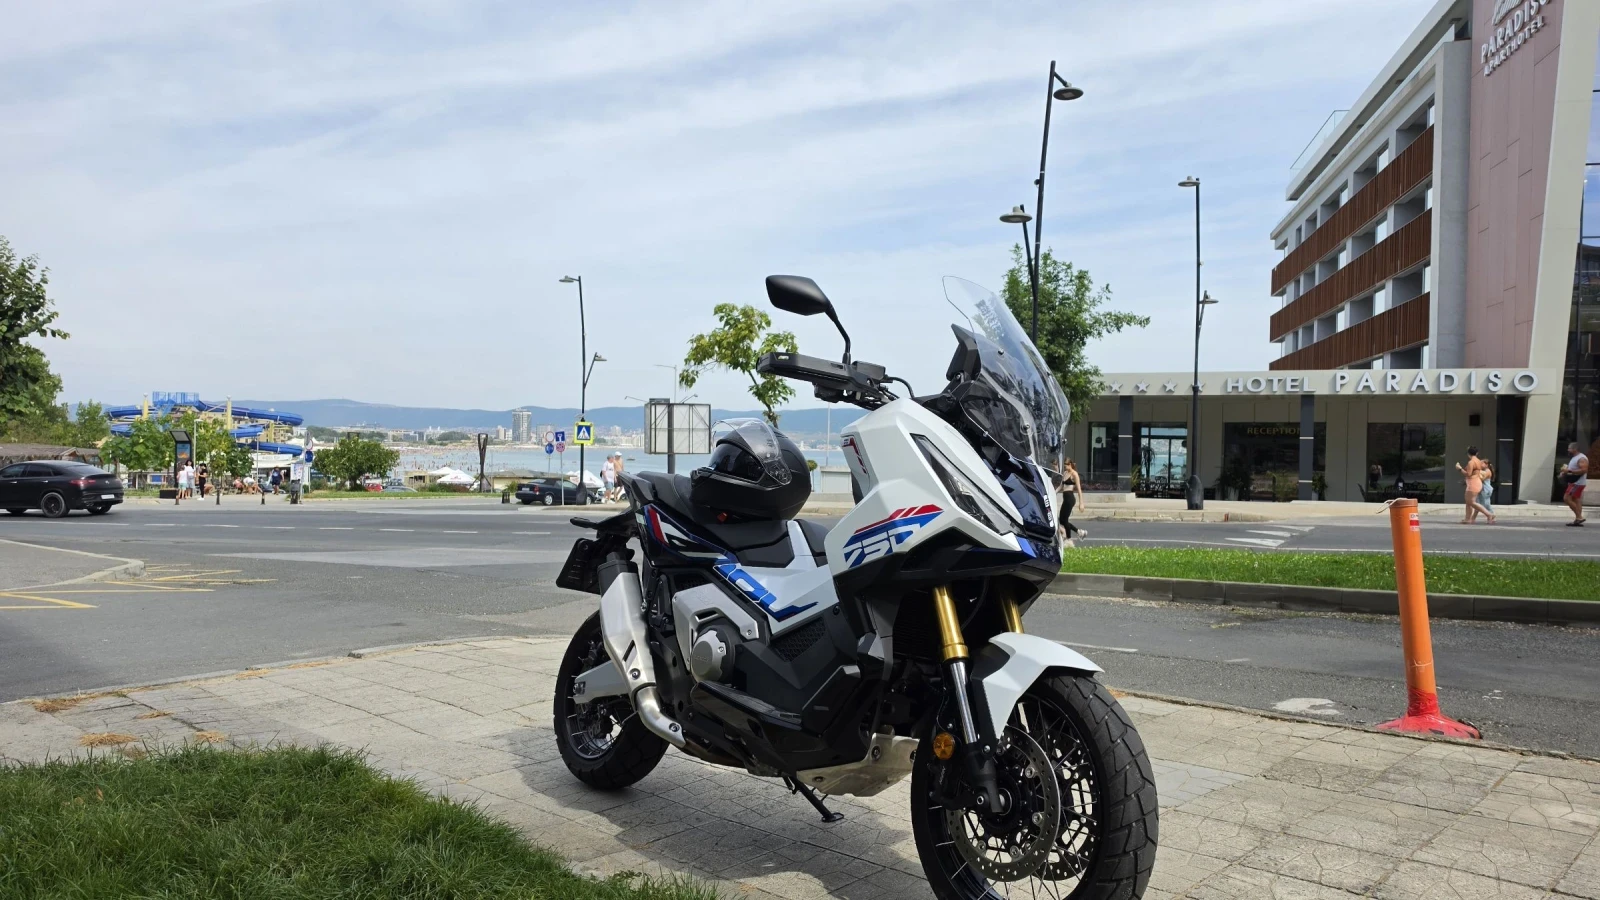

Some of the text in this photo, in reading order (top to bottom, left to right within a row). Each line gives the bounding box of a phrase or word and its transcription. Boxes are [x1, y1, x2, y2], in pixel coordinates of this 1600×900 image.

[1480, 0, 1549, 63] PARADIS
[1484, 15, 1545, 76] APARTHOTEL
[1226, 370, 1539, 393] HOTEL PARADISO
